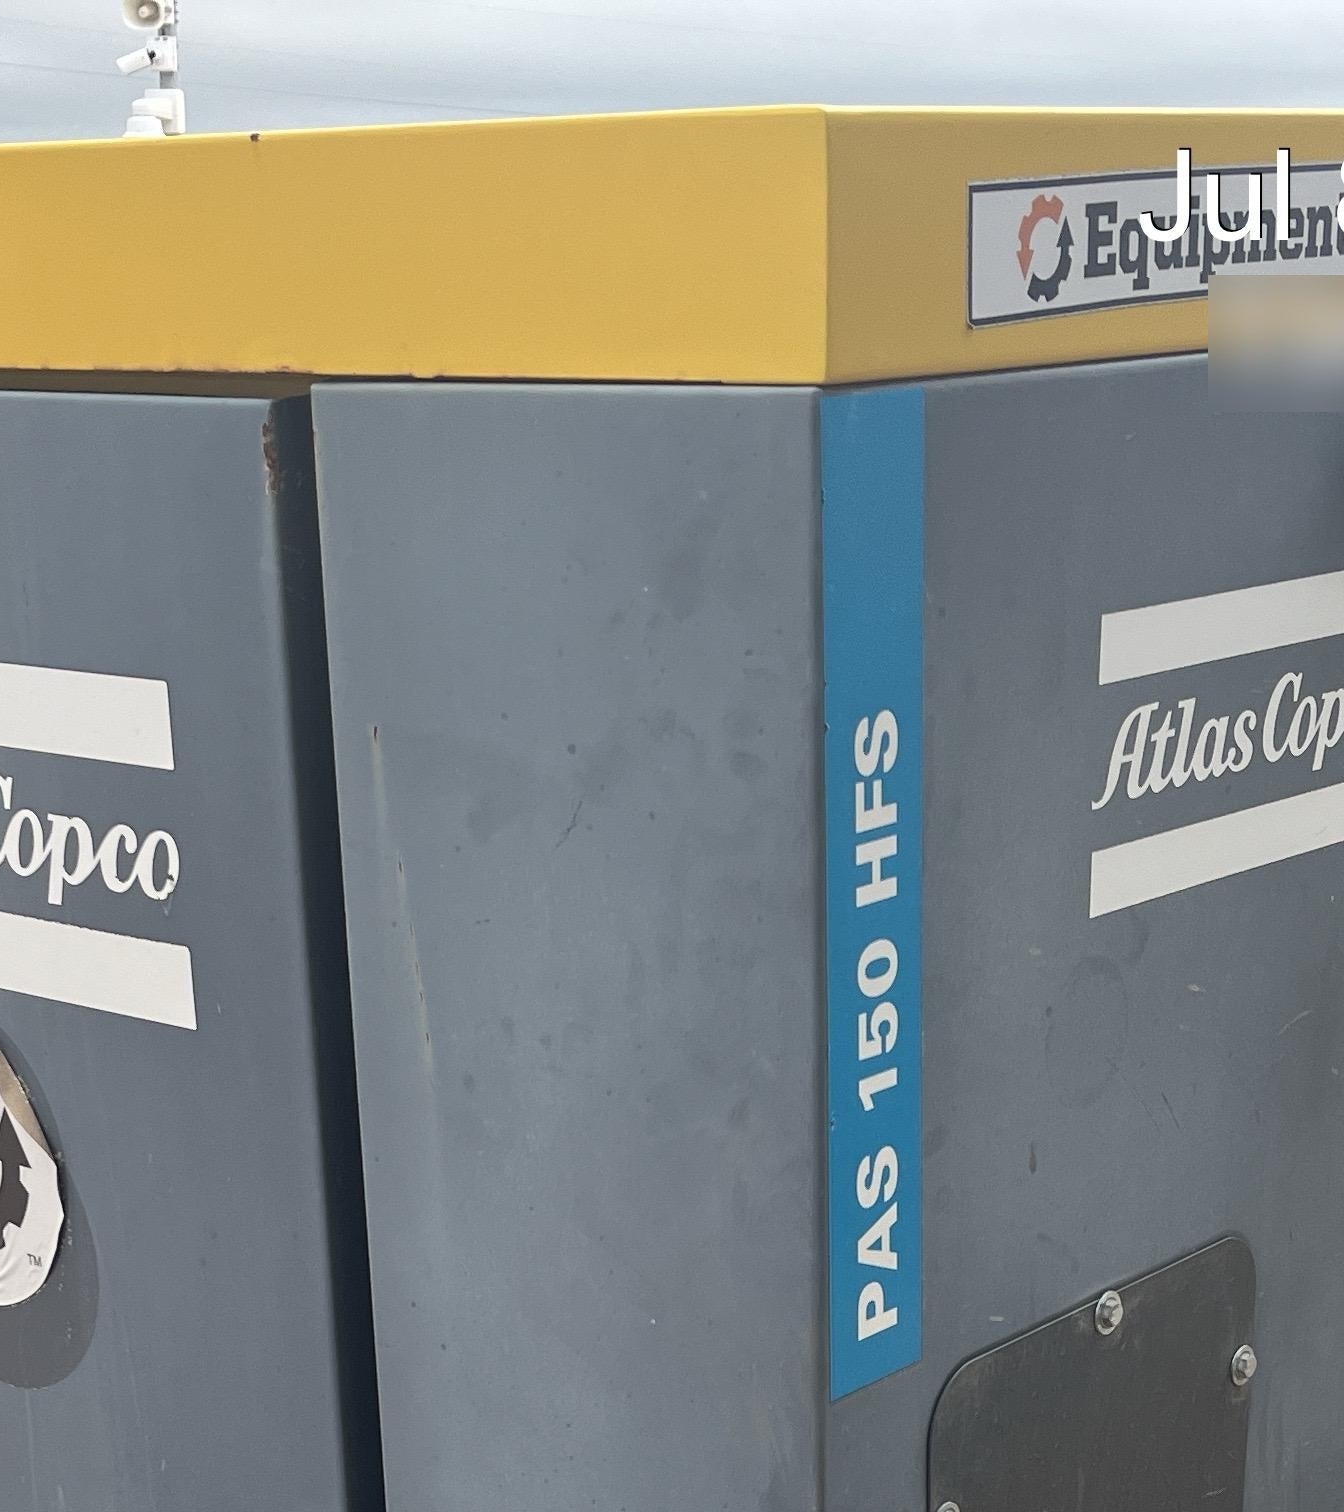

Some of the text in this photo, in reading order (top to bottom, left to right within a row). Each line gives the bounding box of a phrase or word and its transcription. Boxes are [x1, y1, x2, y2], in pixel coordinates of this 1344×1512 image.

[1091, 698, 1258, 811] Atlas
[854, 708, 899, 1342] PAS 150 HFS
